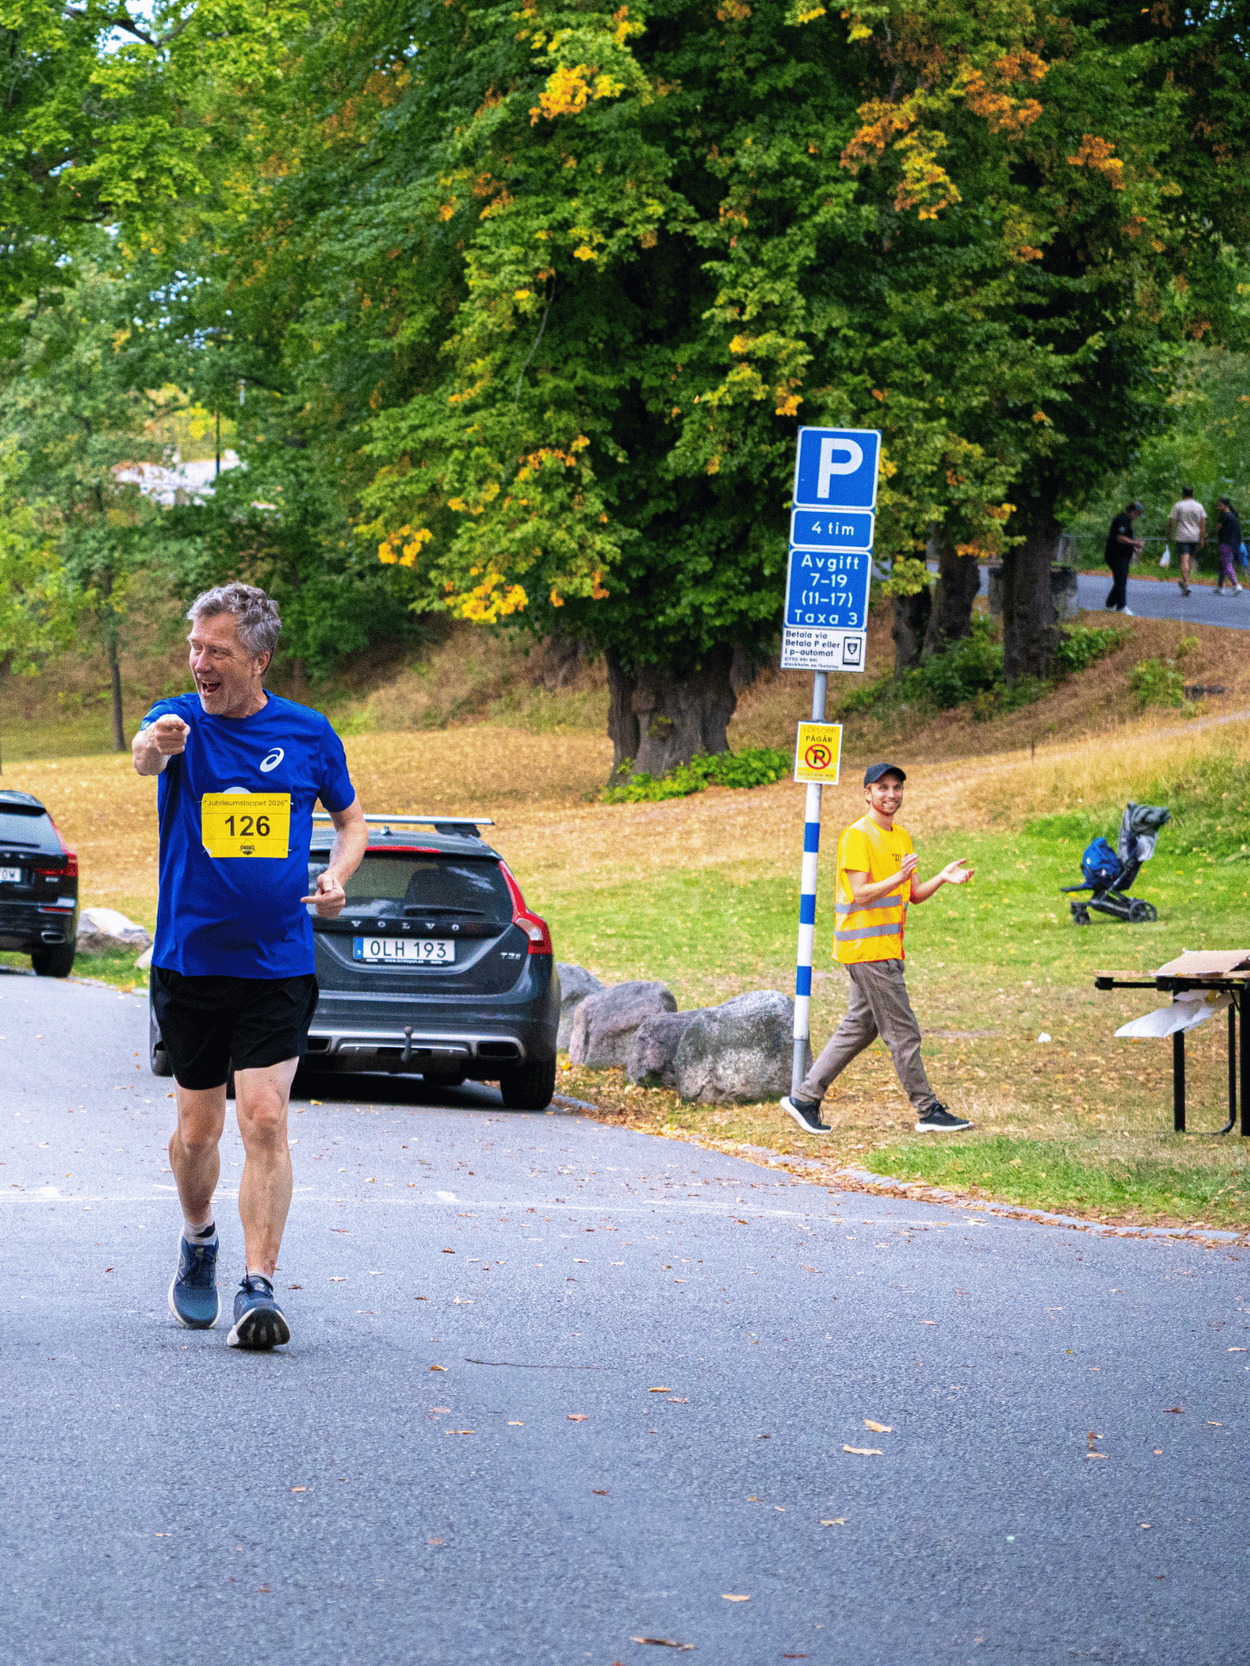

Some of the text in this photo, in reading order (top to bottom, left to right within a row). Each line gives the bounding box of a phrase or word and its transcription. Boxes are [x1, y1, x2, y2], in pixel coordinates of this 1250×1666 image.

[816, 437, 864, 499] P
[811, 521, 854, 536] 4 tim
[800, 554, 859, 572] Avgift
[810, 572, 848, 588] 7-19
[801, 589, 853, 608] (11-17)
[794, 609, 858, 626] Taxa 3
[786, 630, 828, 639] Betala via
[785, 639, 812, 647] Betala
[790, 649, 834, 657] p-automat
[805, 734, 833, 743] PÅGÅR
[224, 815, 271, 837] 126
[350, 920, 460, 932] VOLVO
[370, 940, 447, 958] OLH 193
